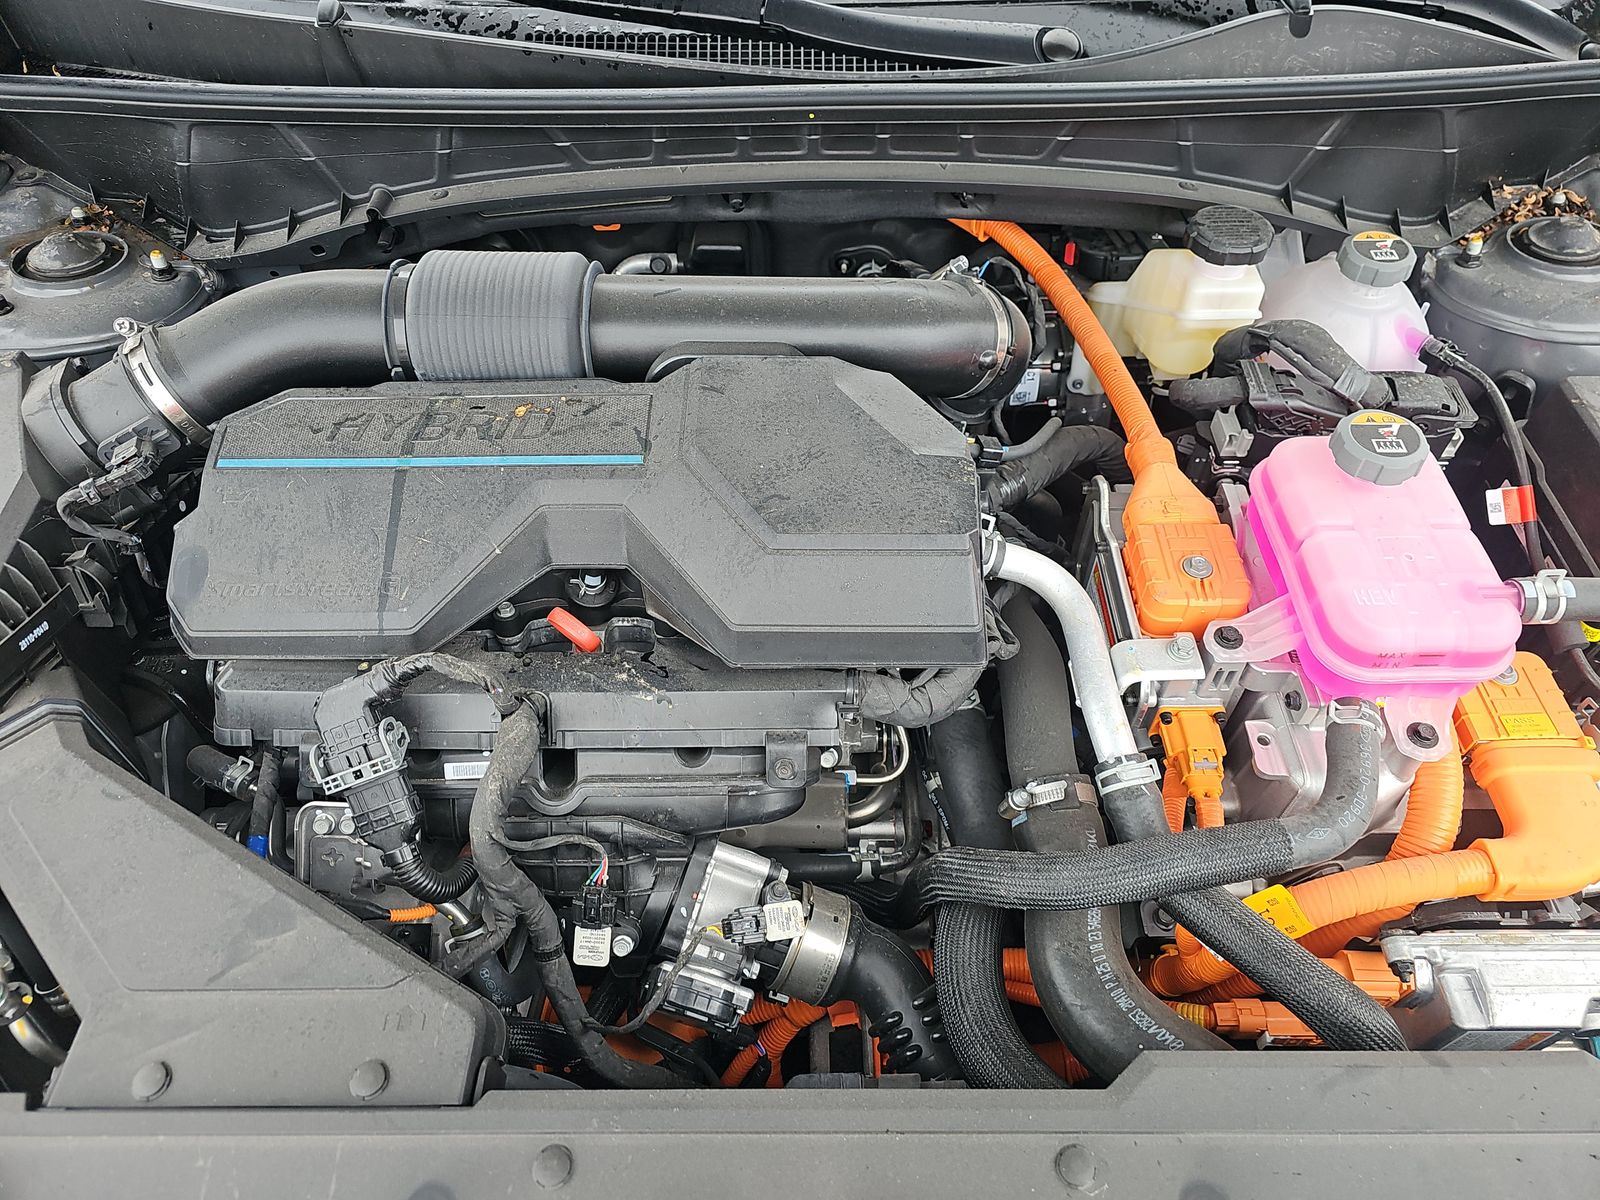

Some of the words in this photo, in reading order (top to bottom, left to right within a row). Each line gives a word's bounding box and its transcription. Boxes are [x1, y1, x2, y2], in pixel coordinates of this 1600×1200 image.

[326, 410, 556, 442] HYBRID
[1378, 652, 1406, 660] MAX
[1371, 661, 1401, 669] MIN
